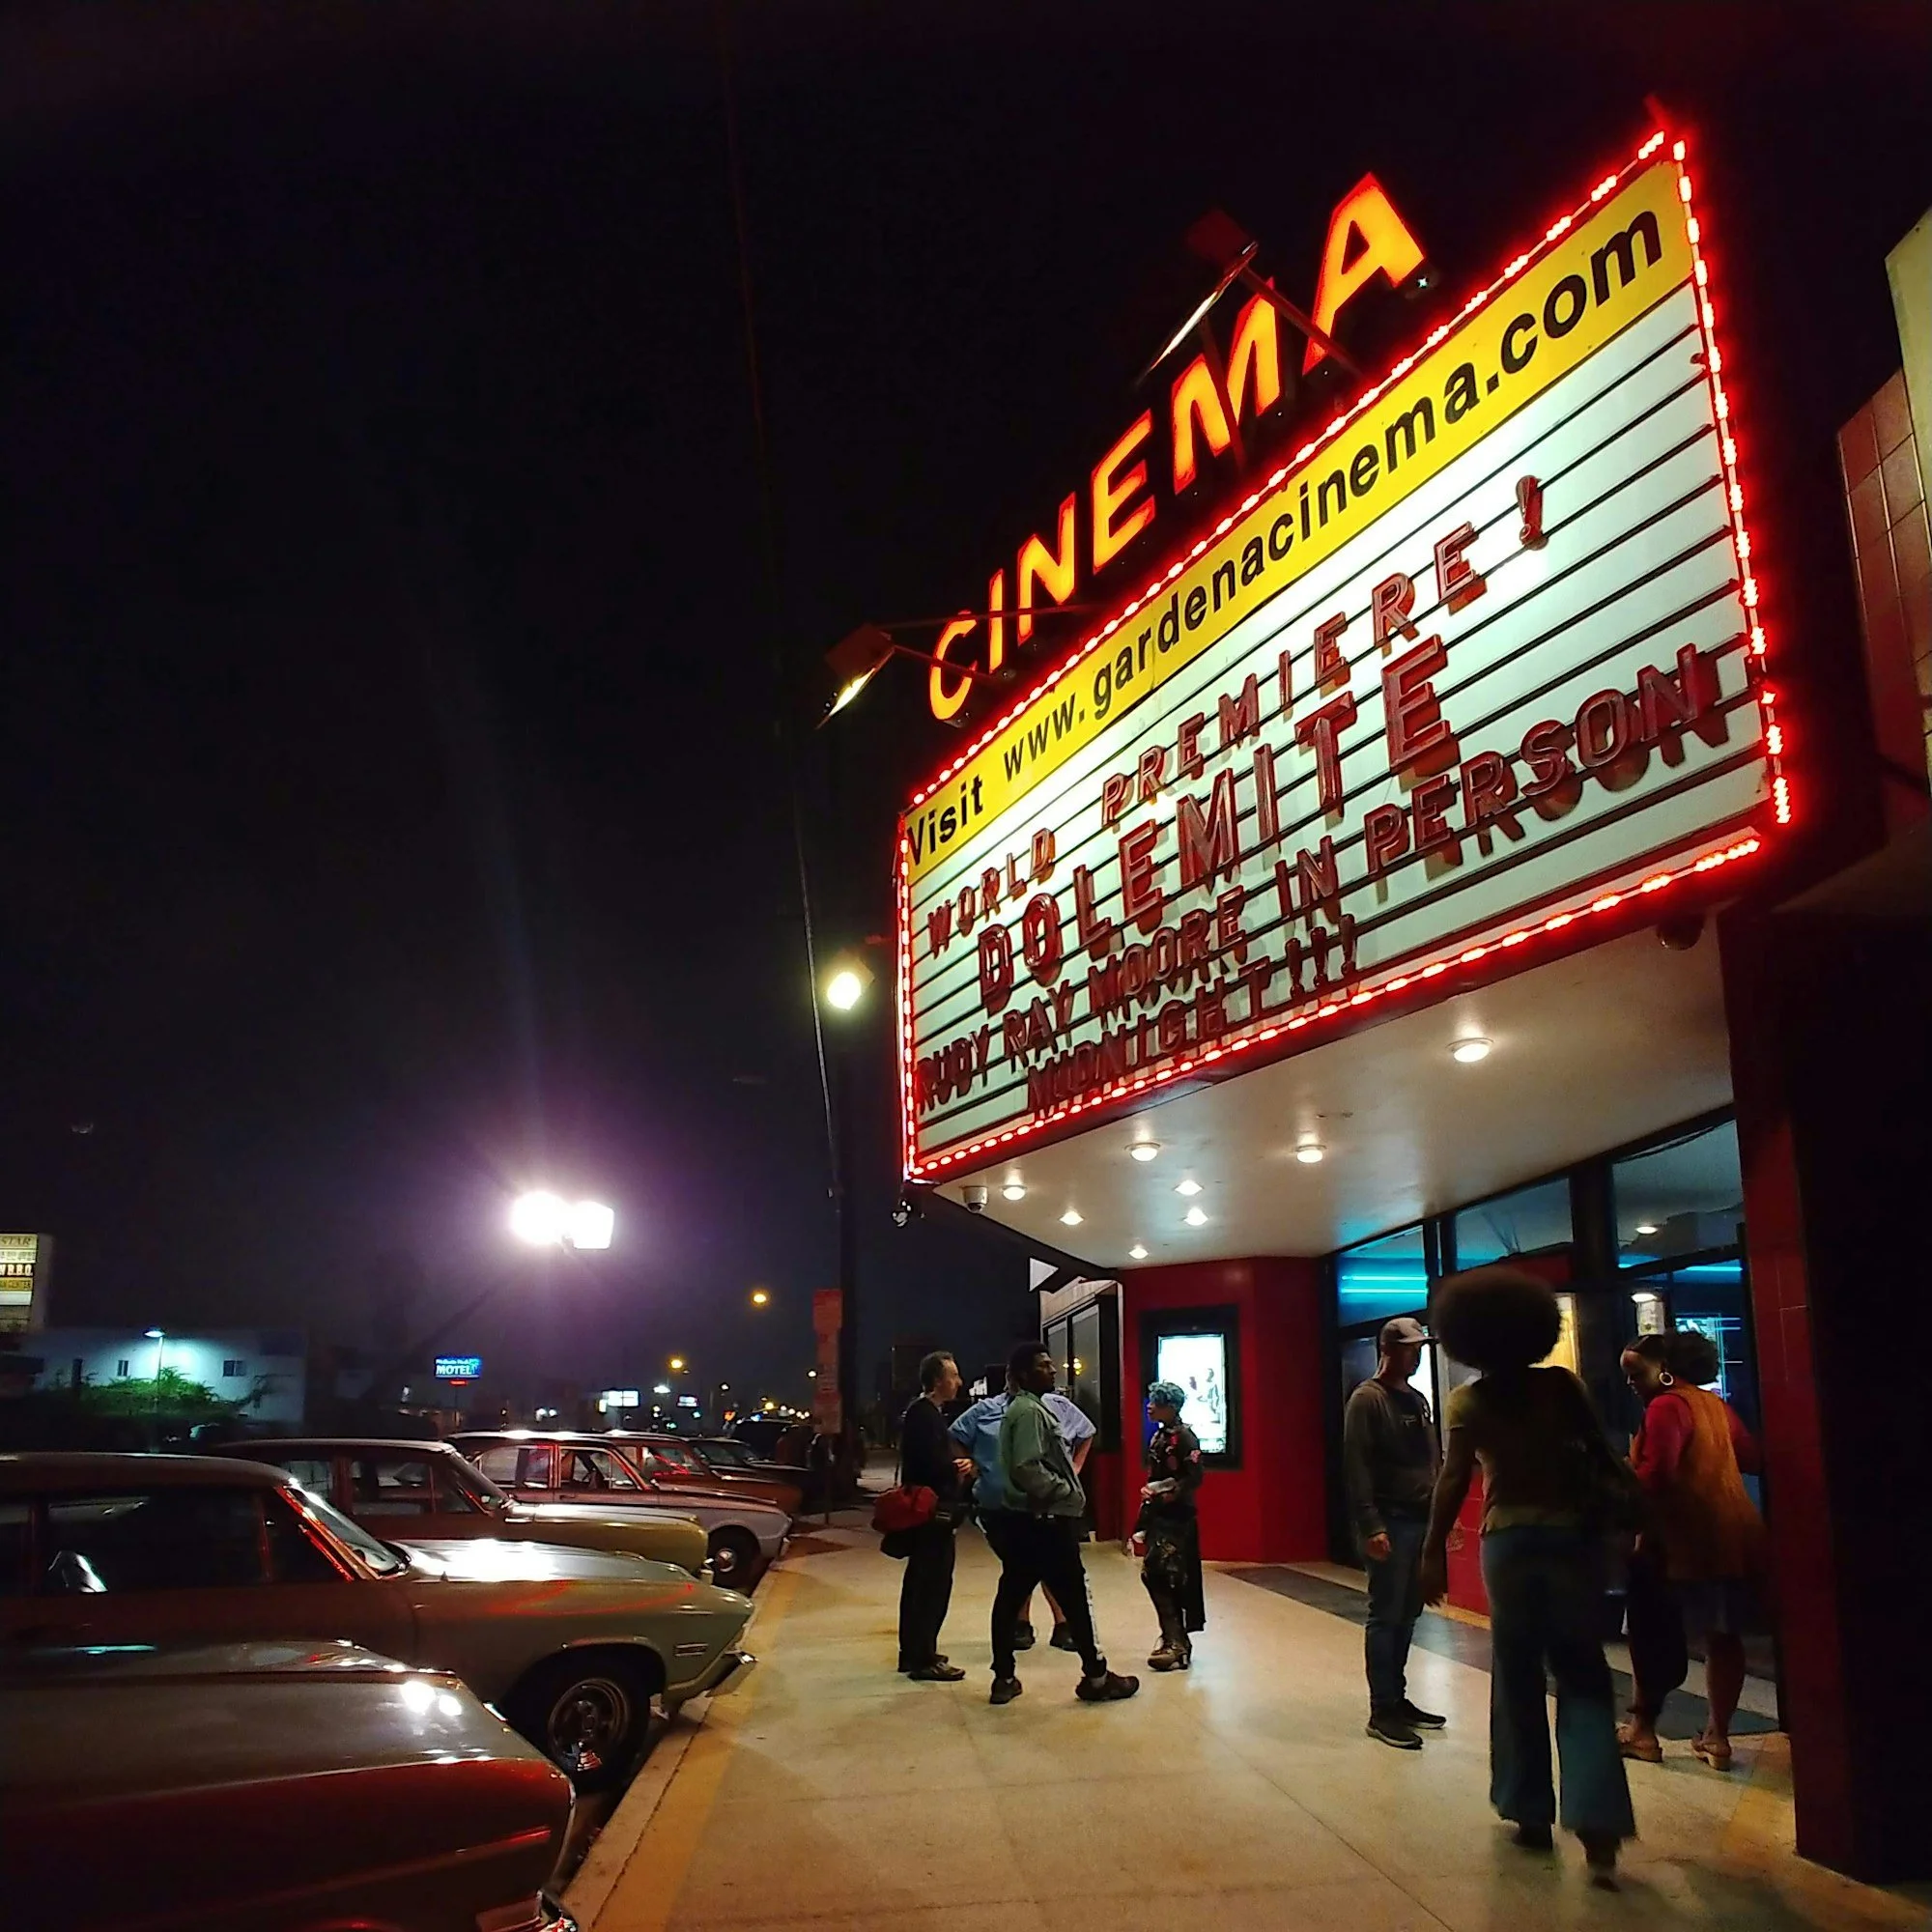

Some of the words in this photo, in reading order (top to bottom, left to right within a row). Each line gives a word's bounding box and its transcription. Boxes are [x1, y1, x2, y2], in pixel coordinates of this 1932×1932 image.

[904, 774, 984, 867] Visit
[1003, 210, 1663, 783] www.gardenacinema.com
[928, 172, 1426, 722] CINEMA
[916, 1024, 990, 1114] RUDY
[1003, 979, 1075, 1068] RAY
[1088, 884, 1247, 1022] MOORE
[1273, 836, 1341, 925] IN
[1363, 642, 1708, 881] PERSON
[927, 827, 1056, 959] WORLD
[978, 634, 1455, 1010] DOLEMITE
[436, 1364, 472, 1375] MOTEL
